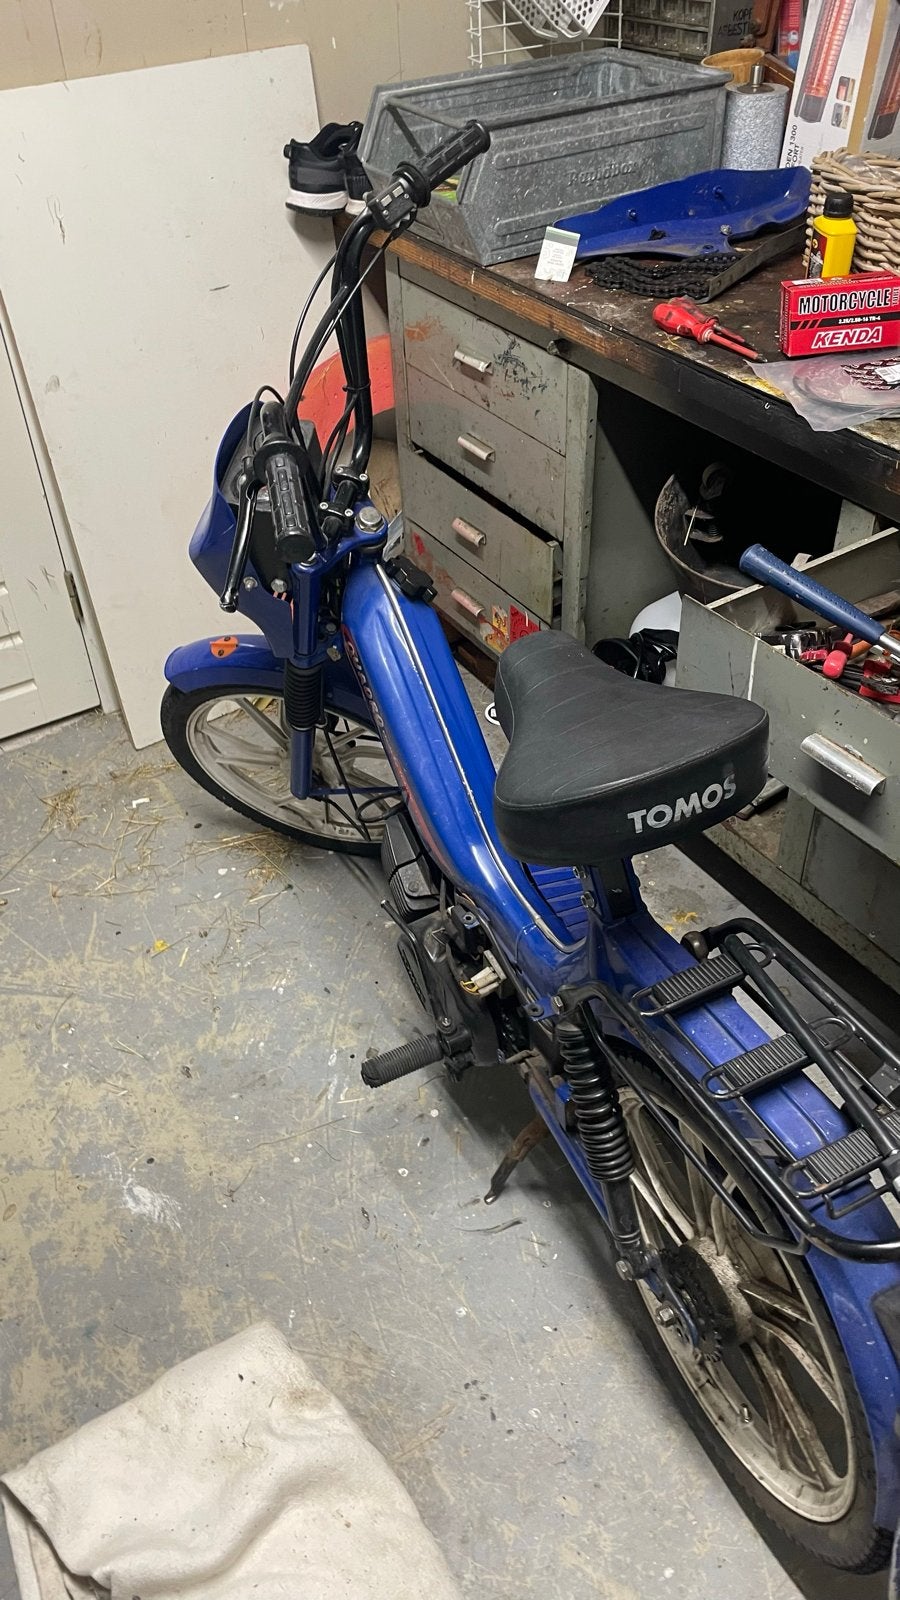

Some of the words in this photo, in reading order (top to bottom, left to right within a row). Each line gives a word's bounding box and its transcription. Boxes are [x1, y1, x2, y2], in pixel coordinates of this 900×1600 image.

[790, 124, 798, 145] 1300
[798, 288, 891, 315] MOTORCYCLE
[811, 326, 883, 349] KENDA
[627, 774, 737, 834] TOMOS
